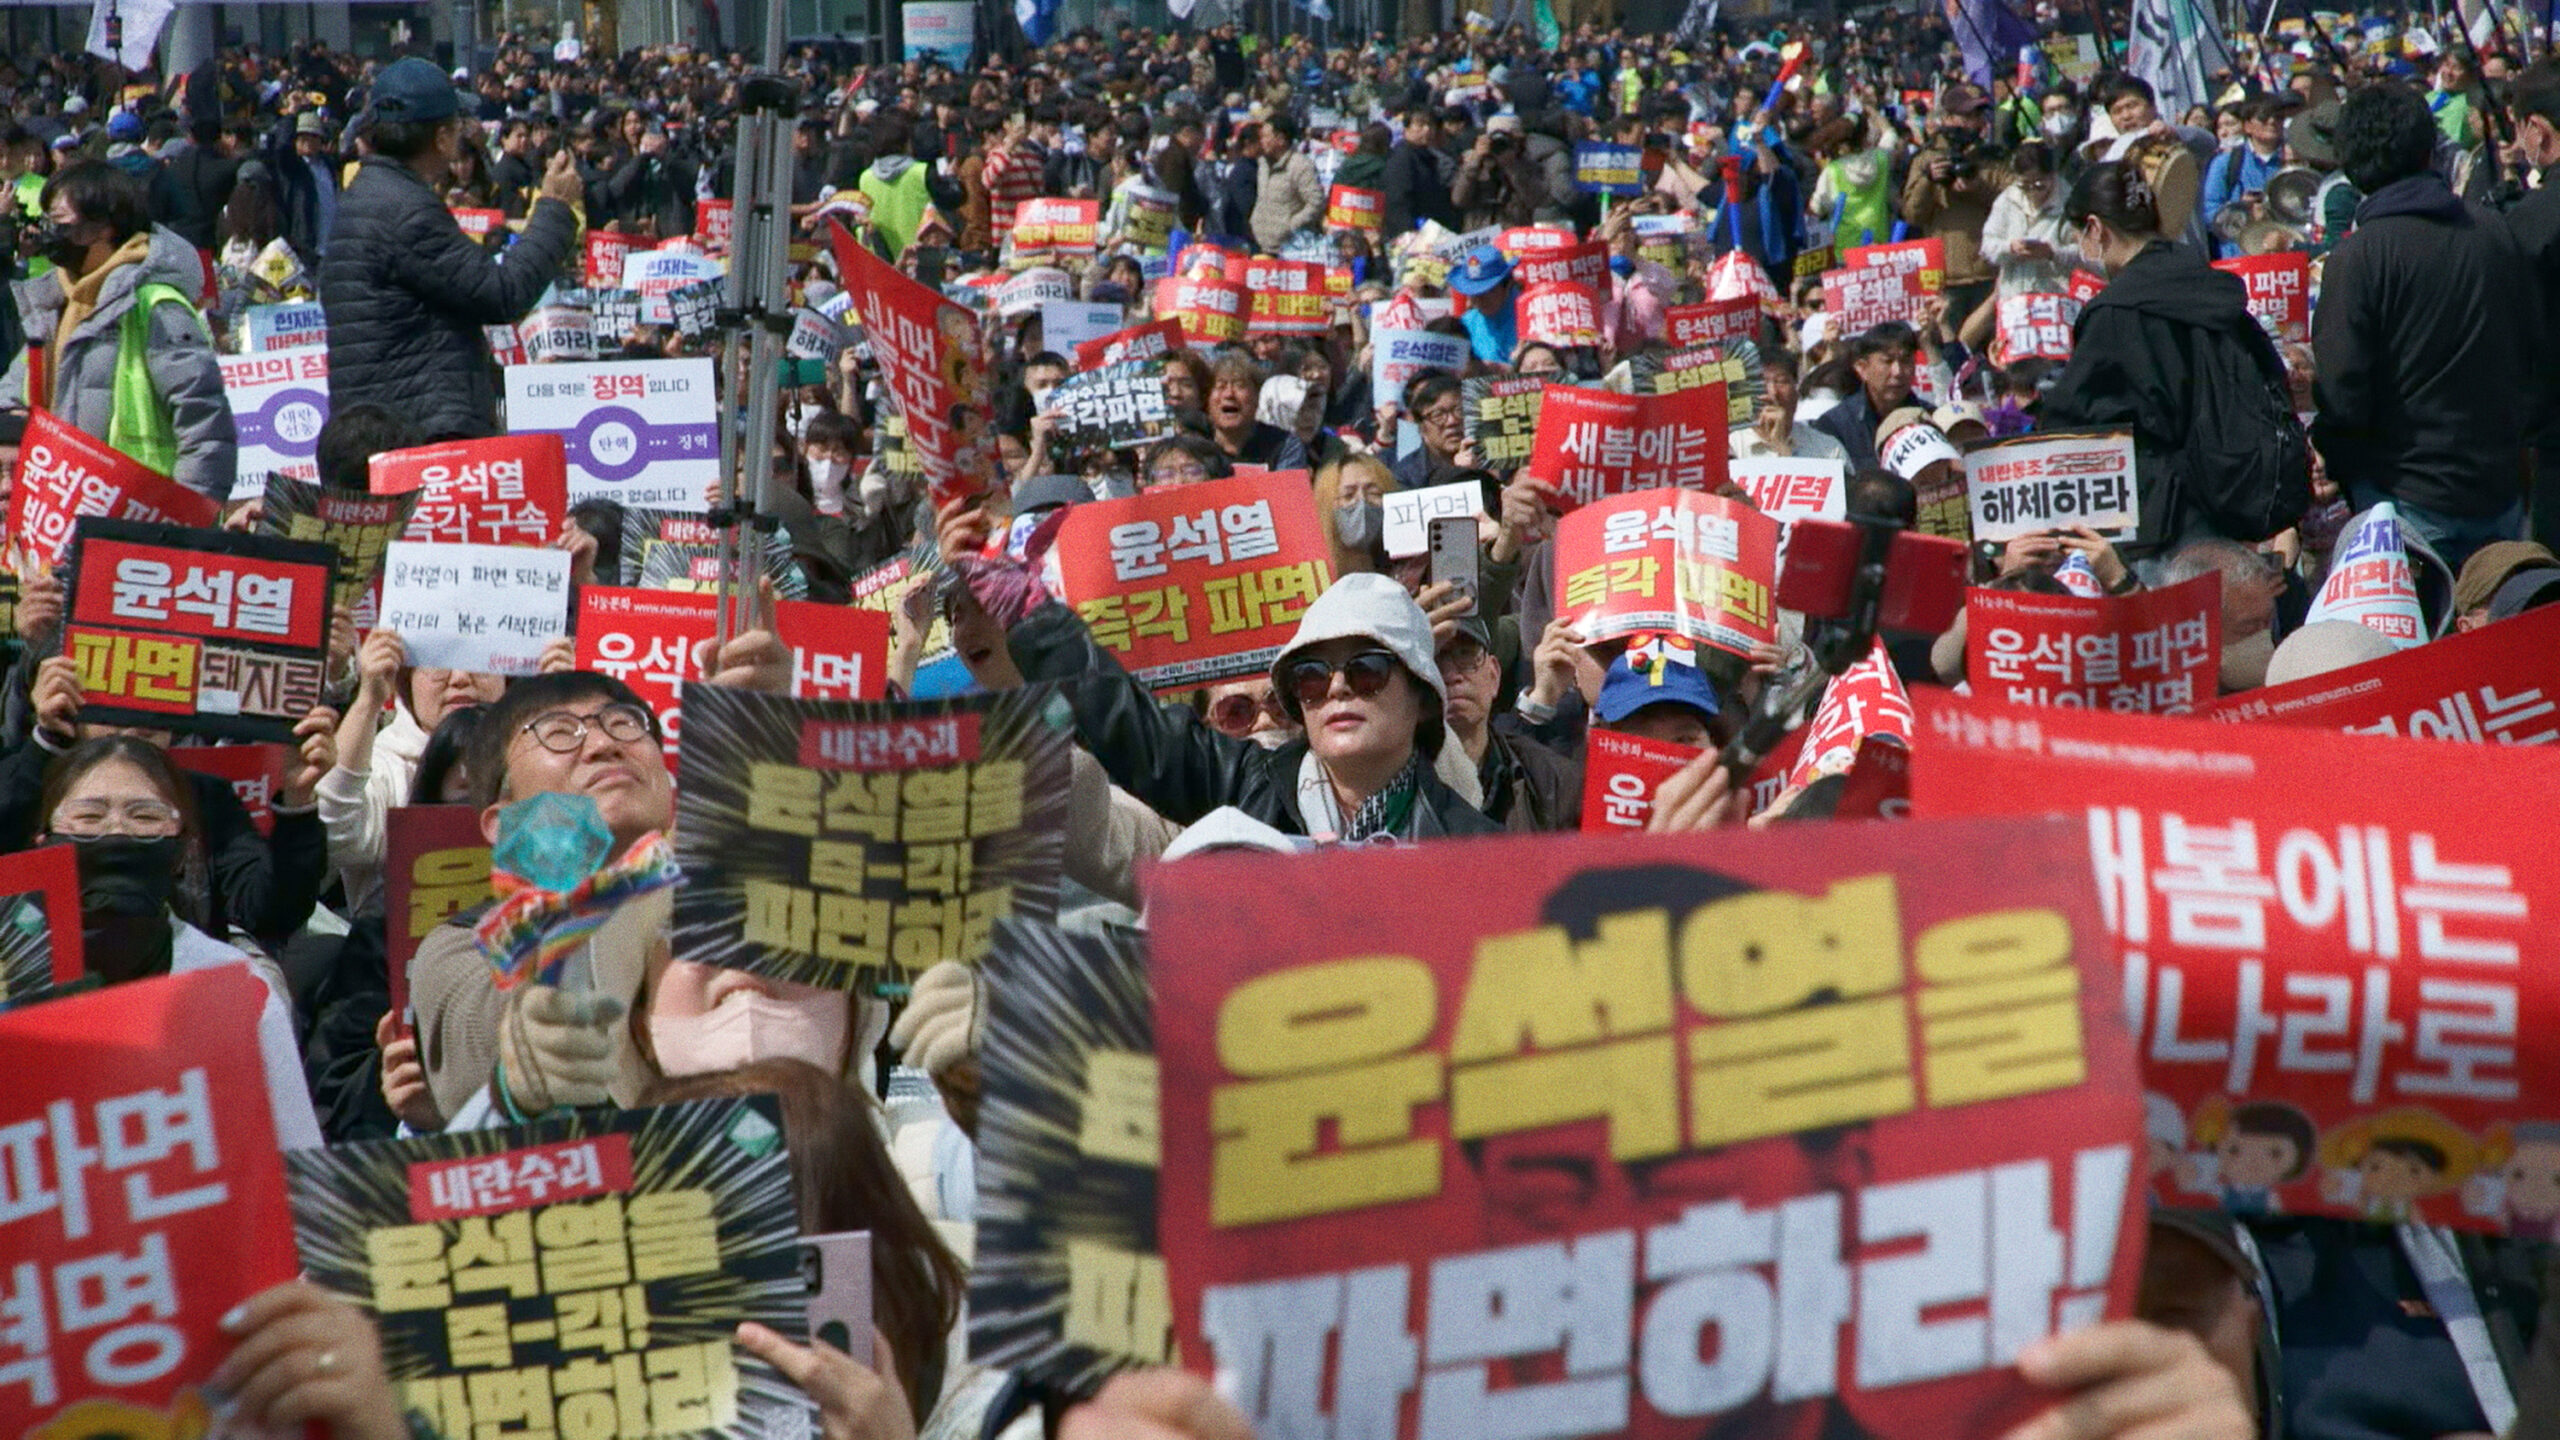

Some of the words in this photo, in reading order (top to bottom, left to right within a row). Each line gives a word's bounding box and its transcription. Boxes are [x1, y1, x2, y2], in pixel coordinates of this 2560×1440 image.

[527, 383, 555, 398] 다음
[558, 380, 585, 397] 역은
[598, 435, 630, 452] 탄핵
[676, 433, 709, 451] 징역
[1559, 421, 1707, 467] 새봄에는
[418, 457, 526, 503] 윤석열
[1980, 476, 2131, 524] 해체하라
[403, 502, 473, 544] 즉각
[478, 500, 550, 542] 구속
[1108, 500, 1281, 582] 윤석열
[1602, 504, 1740, 564] 윤석열
[111, 558, 294, 636] 윤석열
[587, 593, 632, 611] 나눔문화
[1076, 585, 1190, 653] 즉각
[1203, 559, 1333, 637] 파면!
[1565, 556, 1661, 609] 즉각
[1676, 558, 1770, 631] 파면!
[73, 632, 198, 703] 파면
[1985, 626, 2120, 683] 윤석열
[2129, 611, 2209, 671] 파면
[820, 722, 960, 768] 내란수괴
[1930, 709, 2042, 753] 나눔문화
[746, 758, 1027, 842] 윤석열을
[1206, 872, 2088, 1228] 윤석열을
[2122, 950, 2520, 1103] 나라로
[0, 1066, 229, 1241] 파면
[428, 1145, 603, 1212] 내란수괴
[365, 1187, 722, 1313] 윤석열을
[1202, 1144, 2133, 1440] 파면하라!
